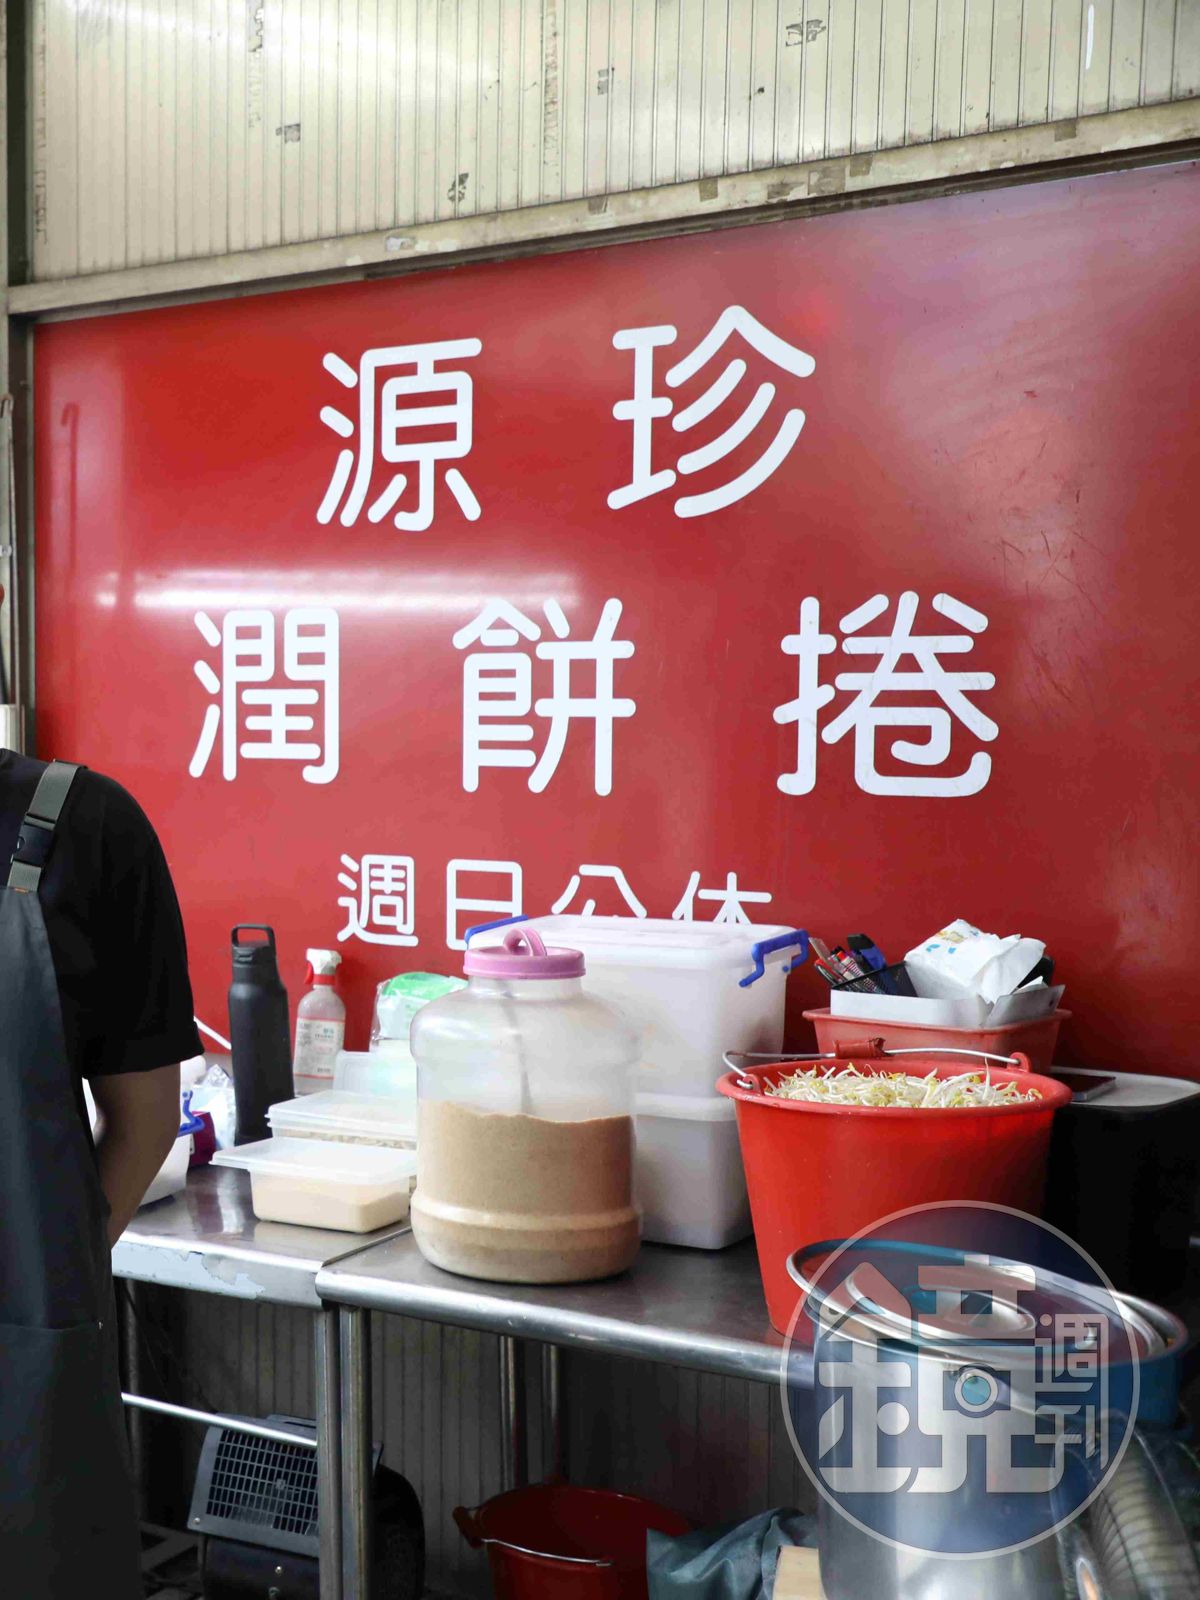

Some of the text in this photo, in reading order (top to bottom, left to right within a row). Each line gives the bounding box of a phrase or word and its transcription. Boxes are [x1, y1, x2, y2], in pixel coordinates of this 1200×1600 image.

[316, 304, 816, 532] 源珍
[188, 590, 1000, 798] 潤餅捲
